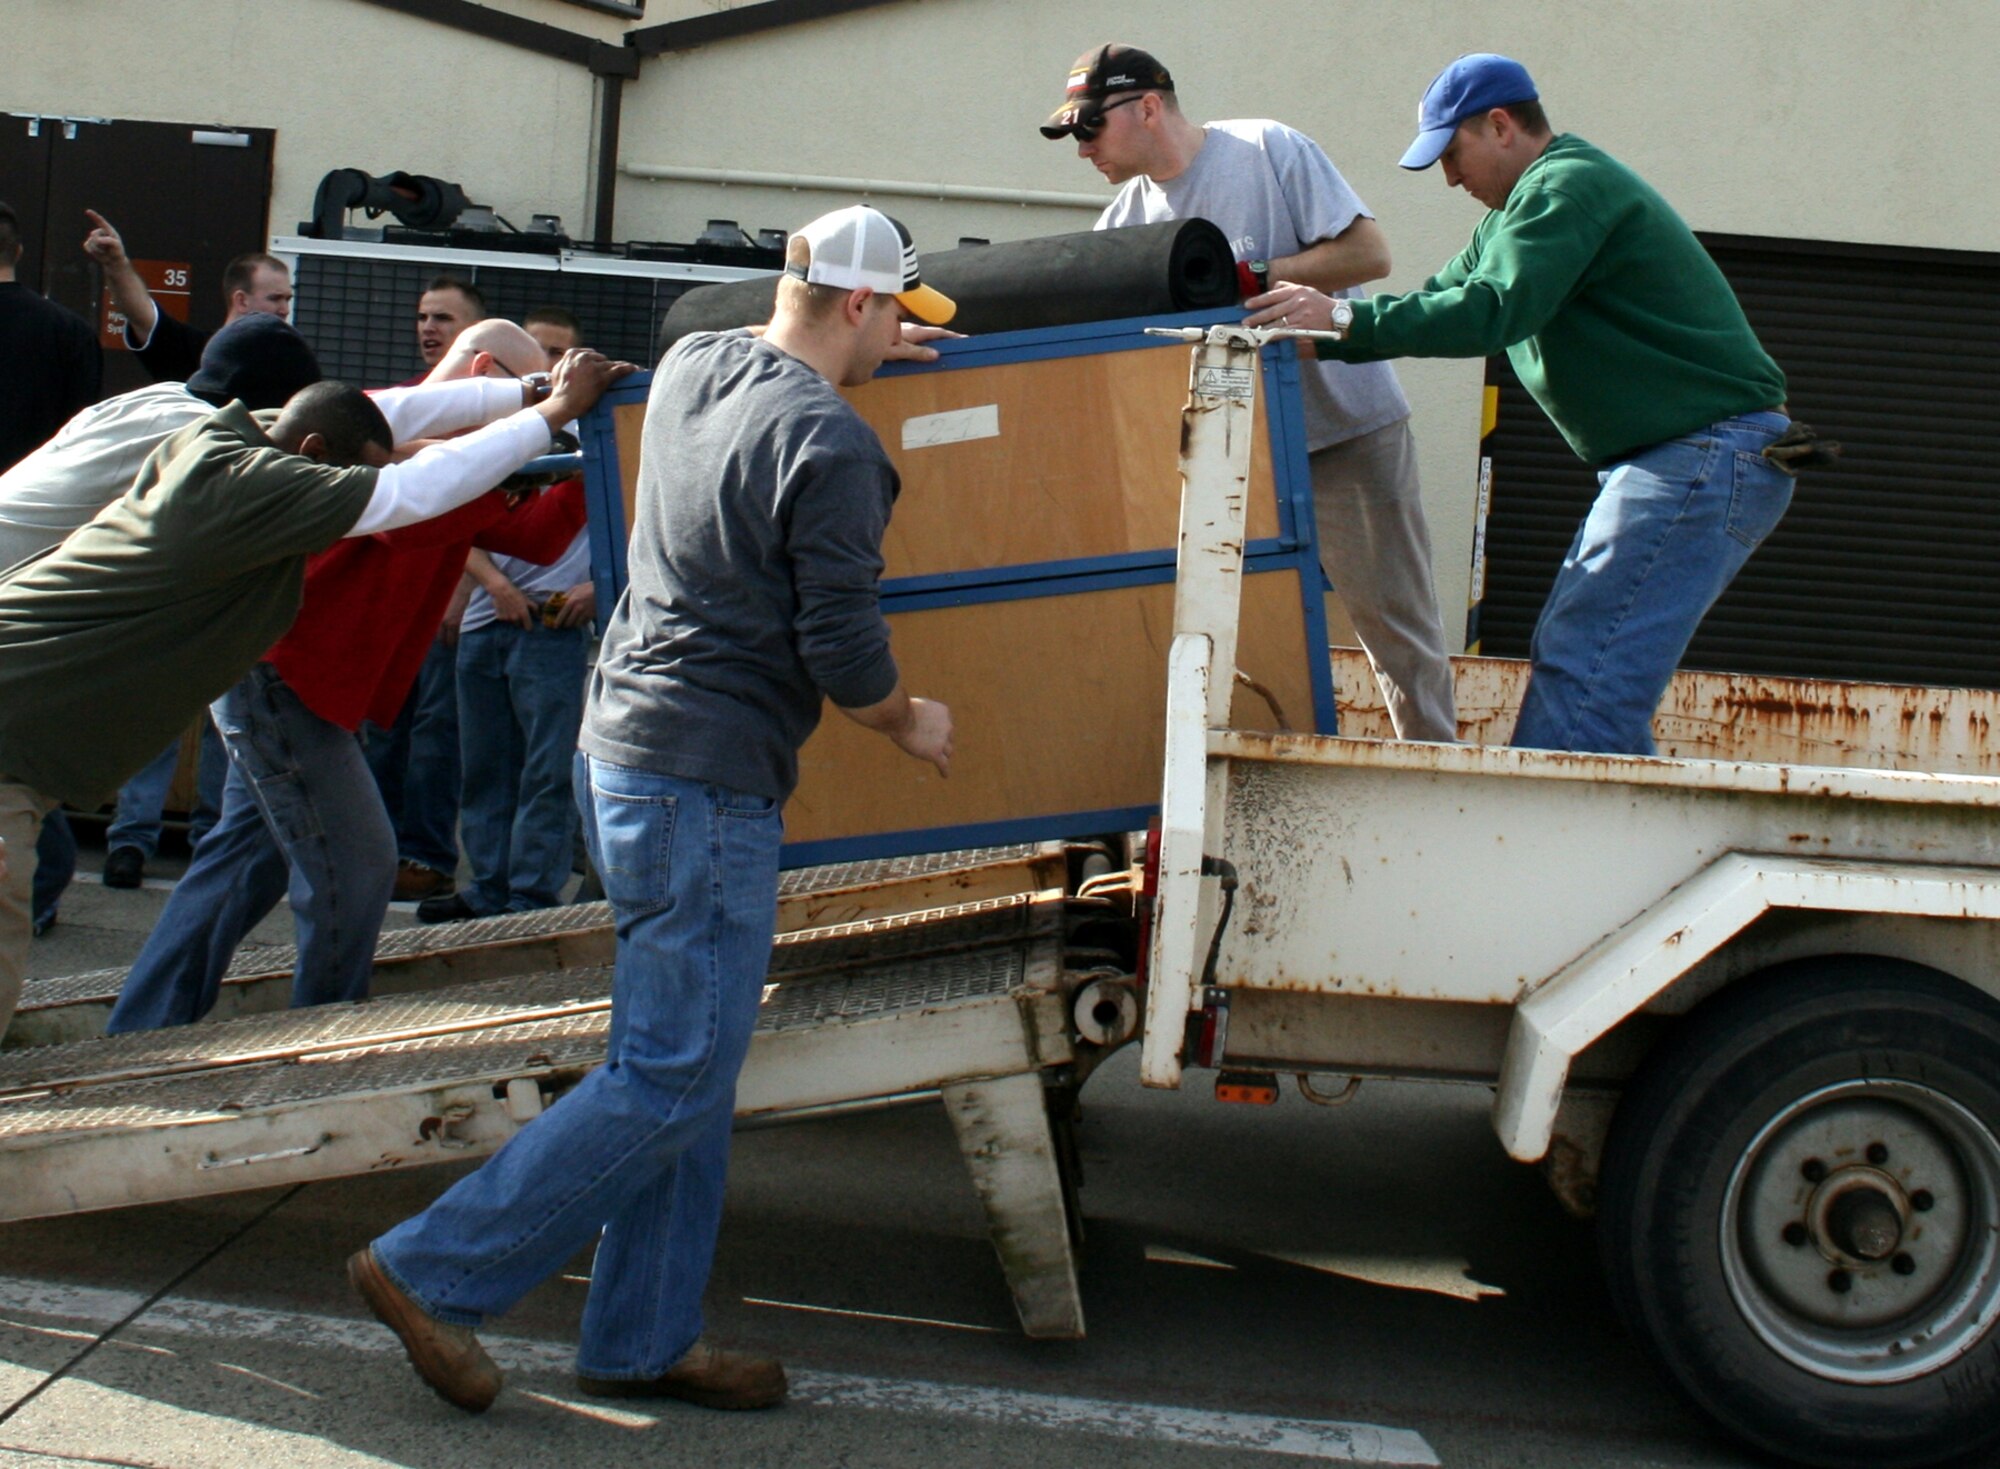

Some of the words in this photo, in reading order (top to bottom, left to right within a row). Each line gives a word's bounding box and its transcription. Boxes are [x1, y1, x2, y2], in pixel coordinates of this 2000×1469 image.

[1061, 109, 1079, 125] 21
[164, 269, 187, 287] 35
[1480, 461, 1490, 515] CRUSH
[1473, 531, 1484, 598] HAZARD
